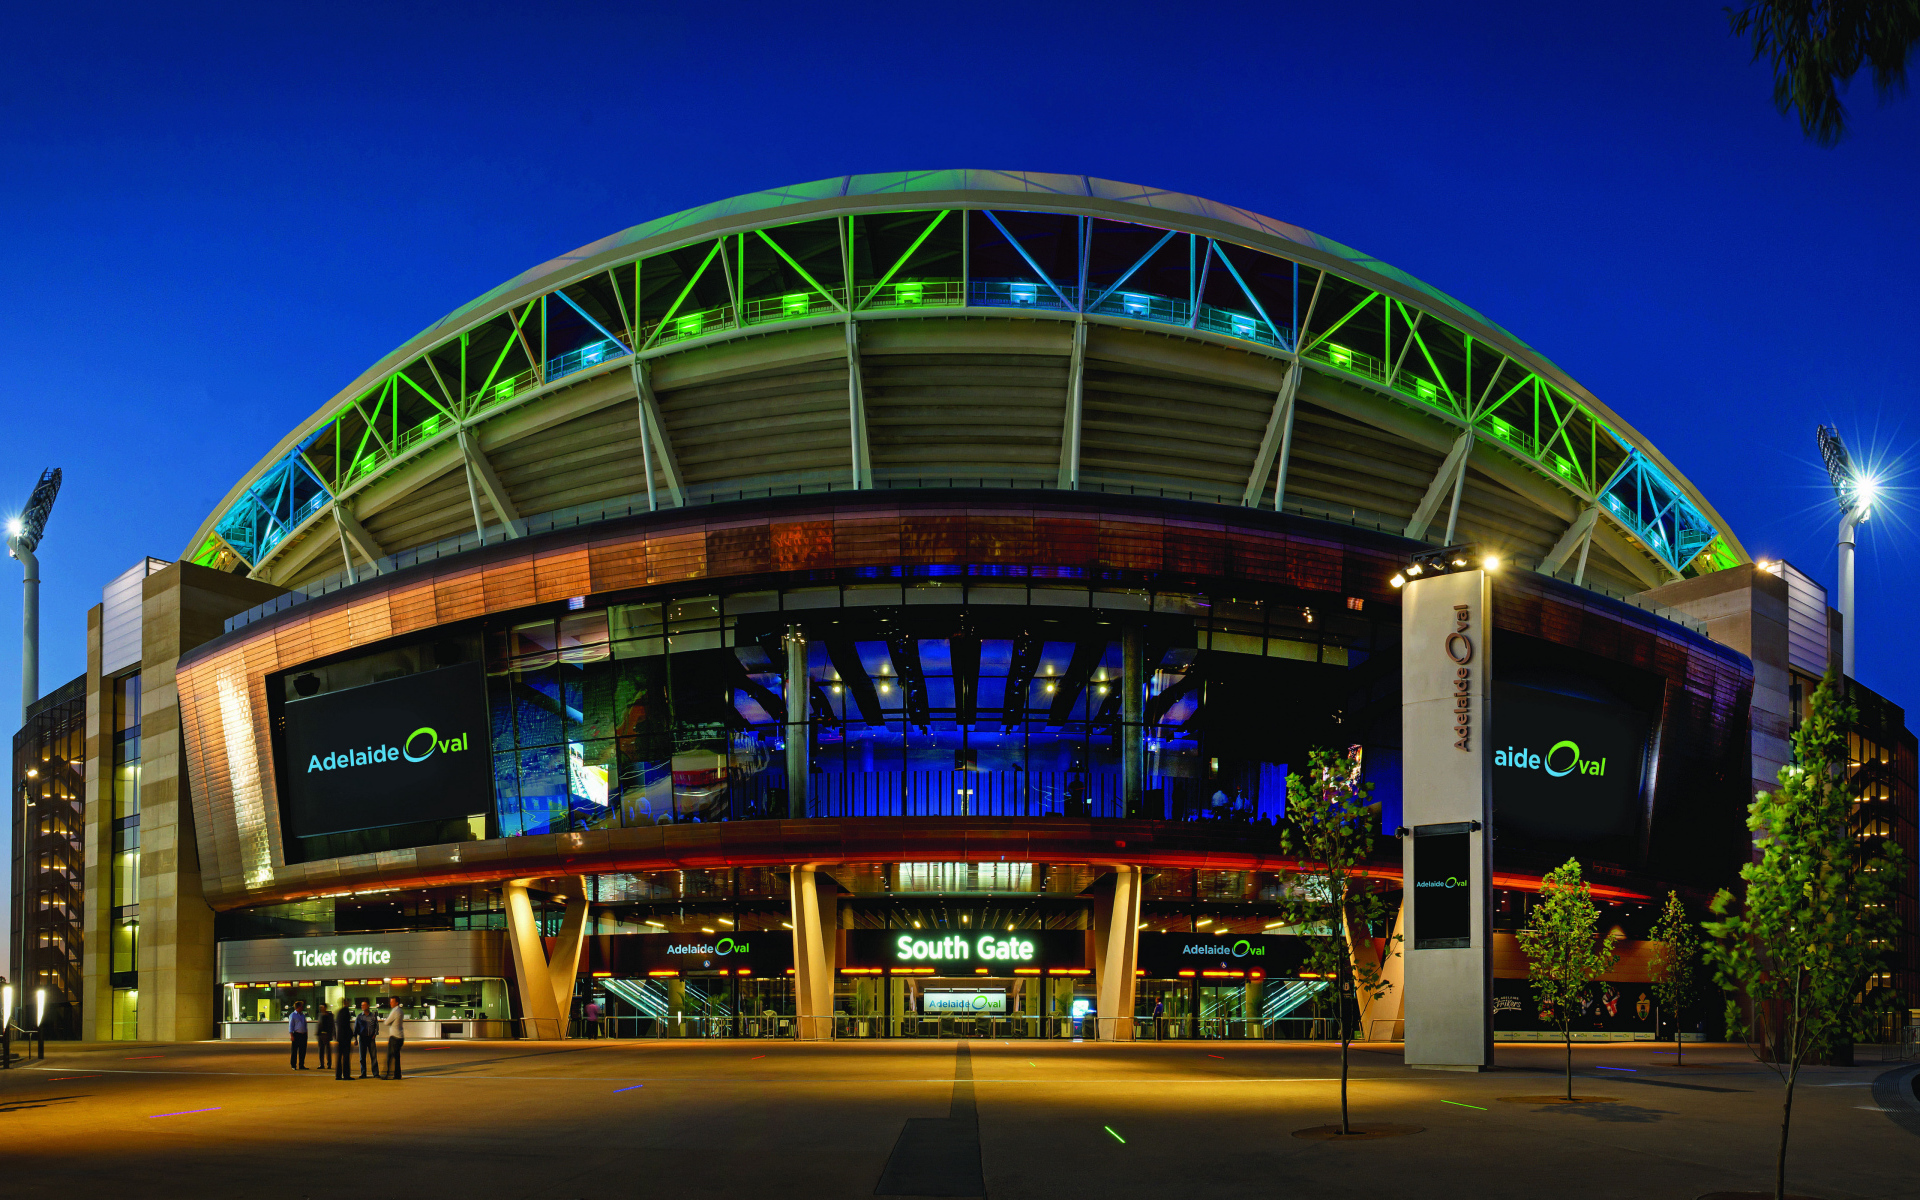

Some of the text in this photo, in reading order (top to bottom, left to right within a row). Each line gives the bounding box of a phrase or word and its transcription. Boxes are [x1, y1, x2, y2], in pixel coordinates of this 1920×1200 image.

[1445, 604, 1472, 752] Adelaide Oval
[307, 727, 468, 773] Adelaide Oval
[1544, 740, 1607, 777] Oval
[1416, 876, 1467, 888] Adelaide Oval
[666, 937, 750, 956] Adelaide Oval
[897, 935, 1034, 960] South Gate
[1182, 939, 1265, 958] Adelaide Oval
[293, 947, 391, 967] Ticket Office
[929, 995, 1001, 1010] Adelaide Oval
